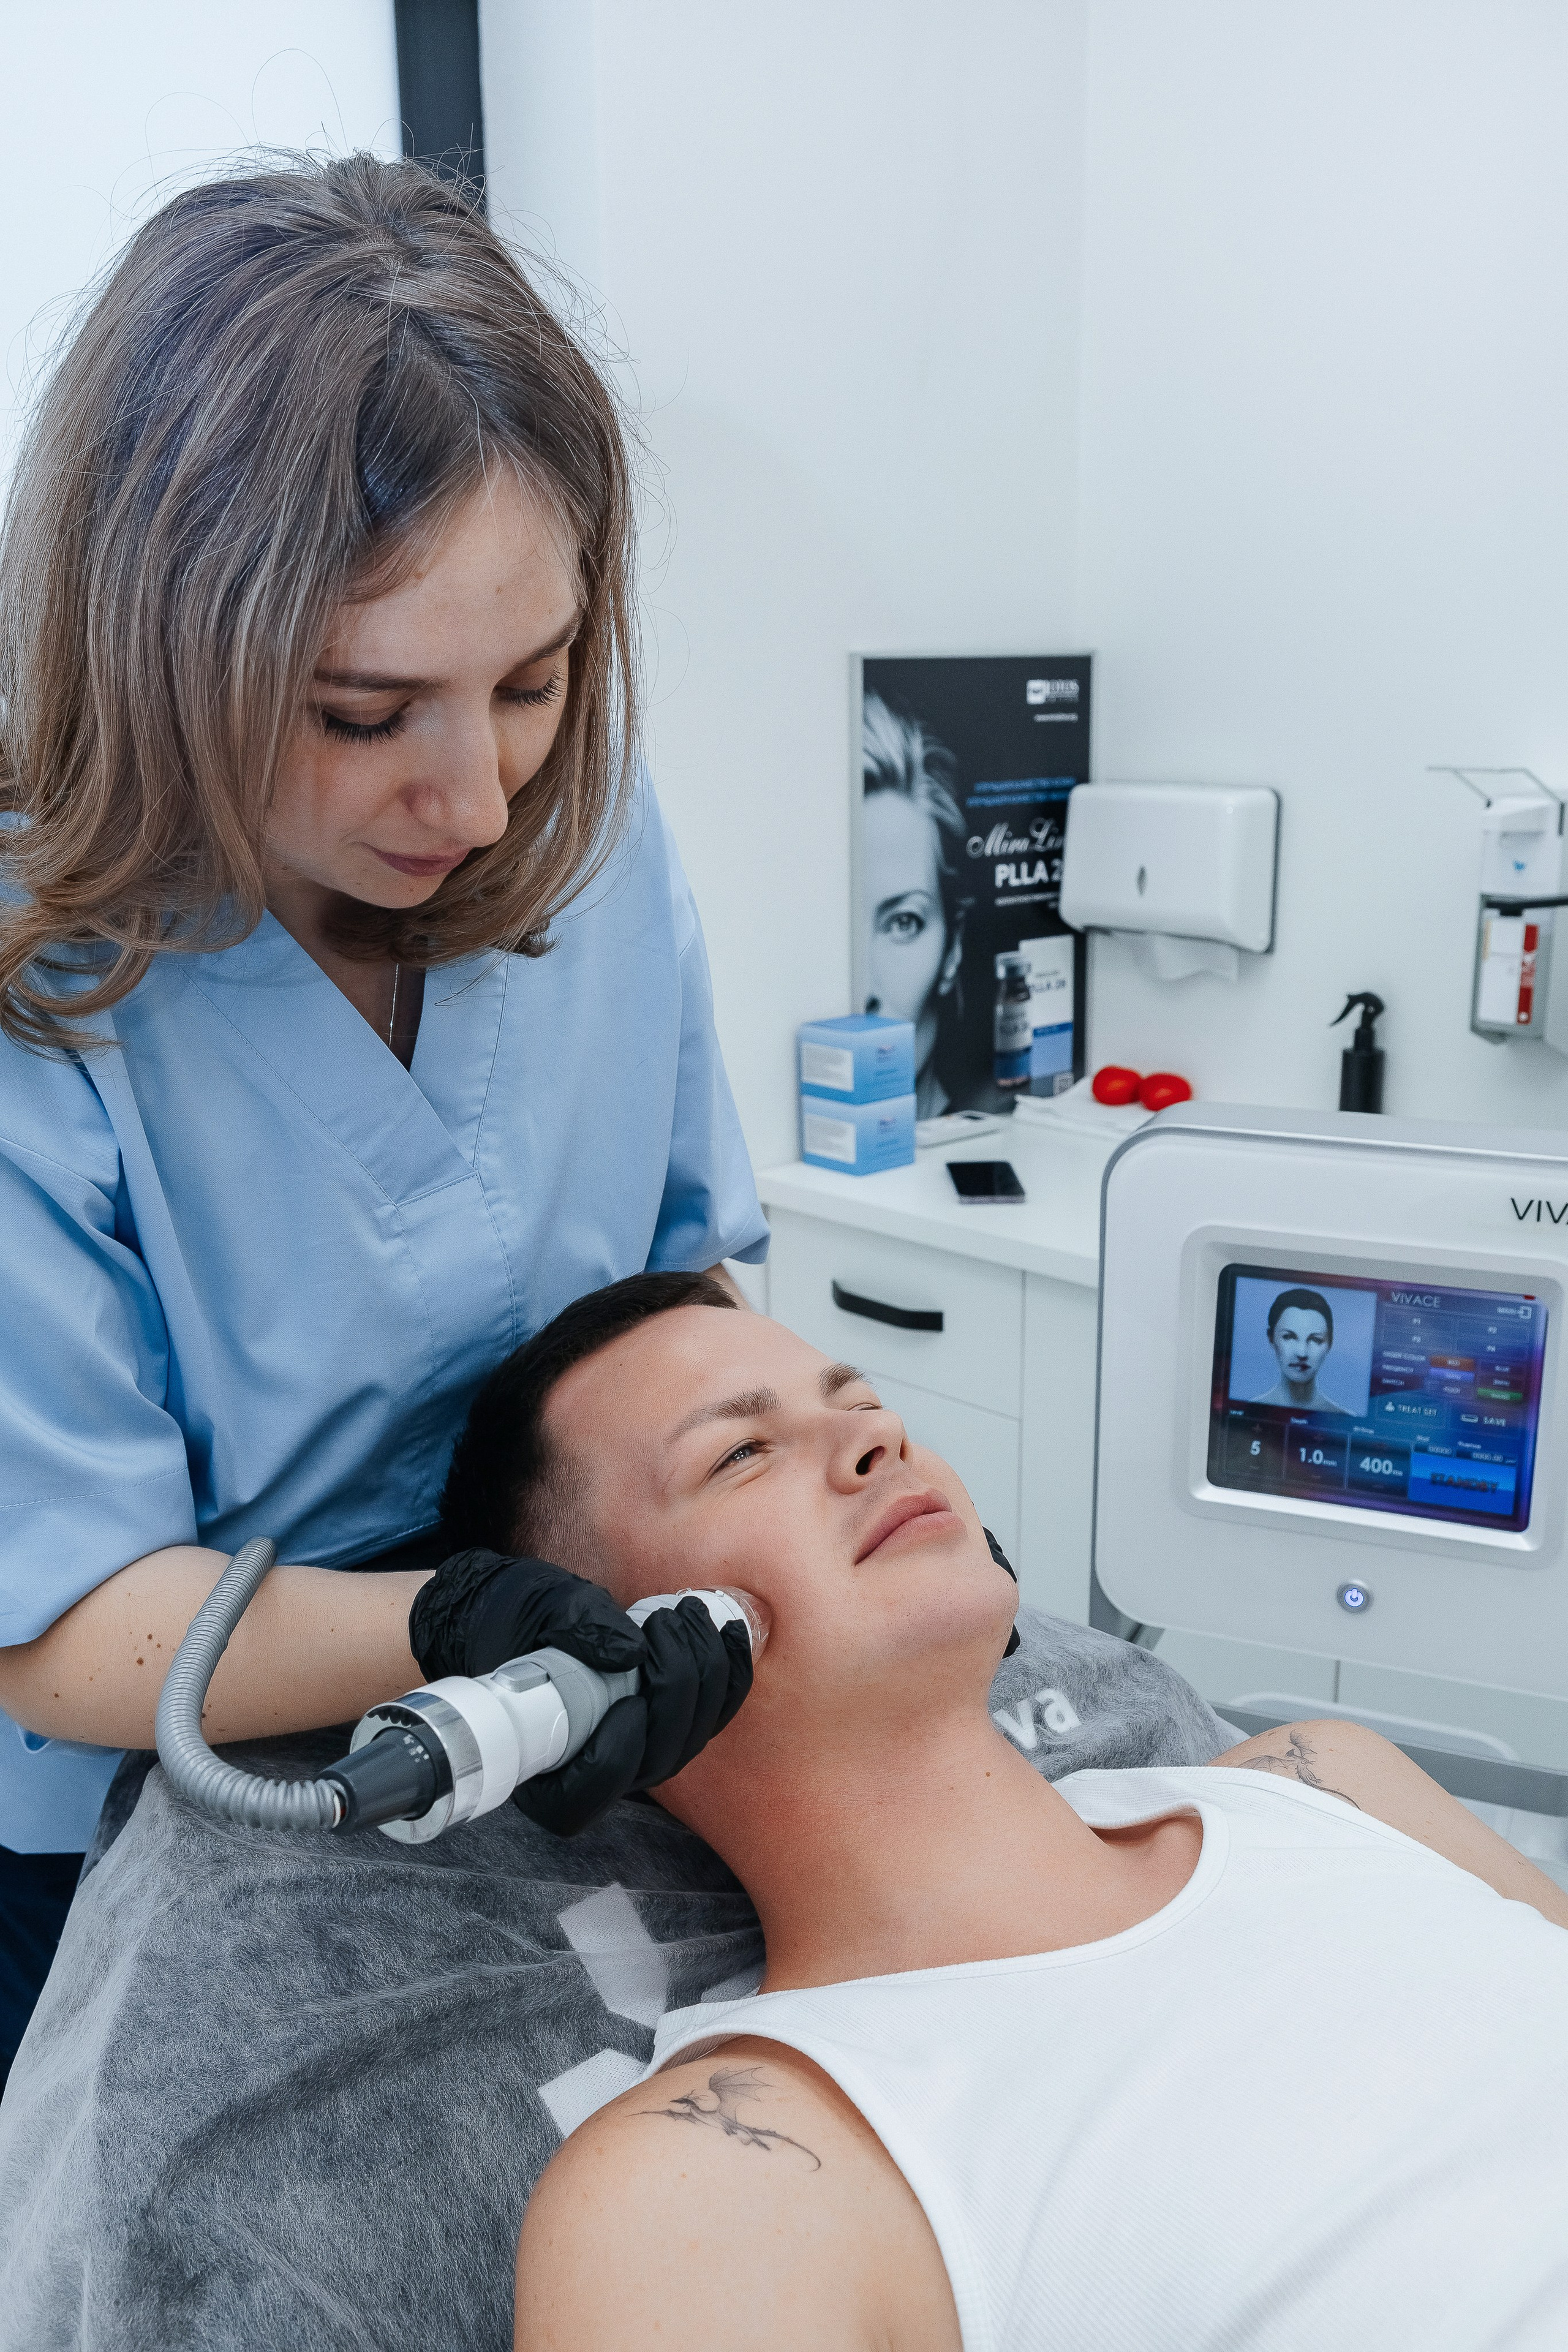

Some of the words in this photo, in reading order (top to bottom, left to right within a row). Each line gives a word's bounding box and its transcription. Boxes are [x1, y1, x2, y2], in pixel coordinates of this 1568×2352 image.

[995, 859, 1049, 888] PLLA
[1510, 1197, 1568, 1225] VIV
[1391, 1291, 1440, 1308] VIVACE
[1398, 1403, 1421, 1414] TREAT
[1424, 1408, 1437, 1417] SET
[1483, 1416, 1506, 1427] SAVE
[1250, 1440, 1261, 1455] 5
